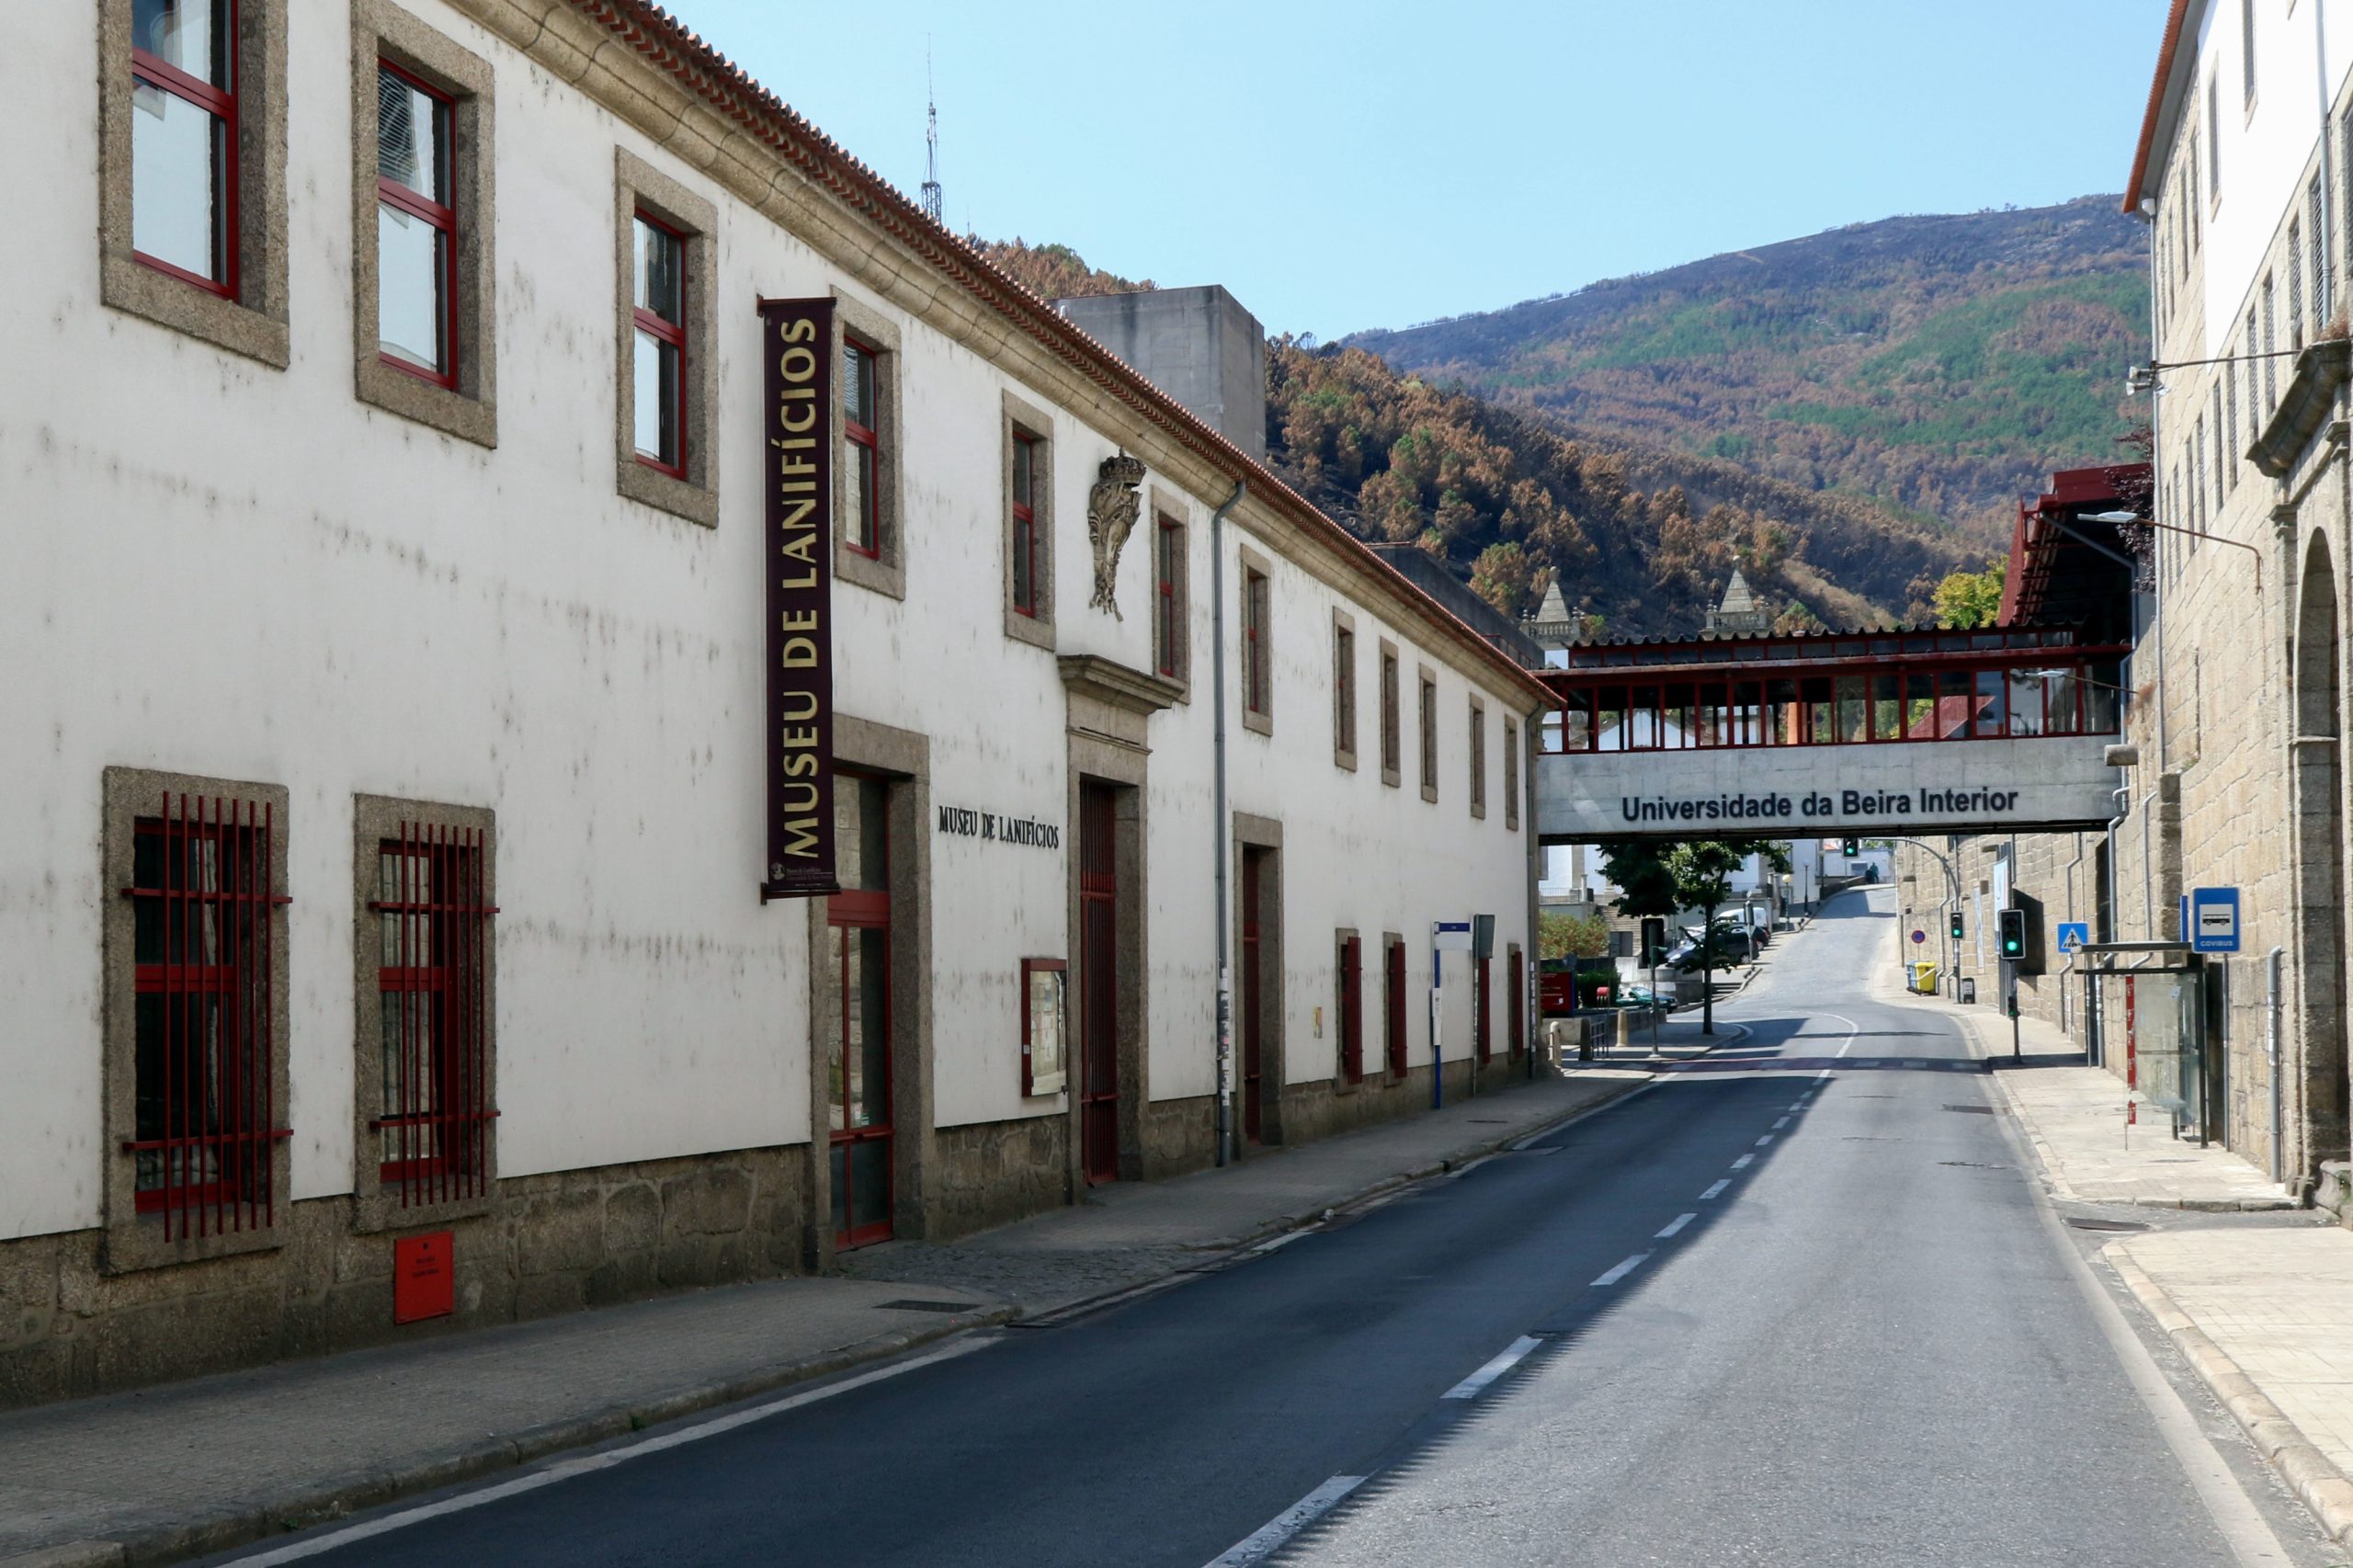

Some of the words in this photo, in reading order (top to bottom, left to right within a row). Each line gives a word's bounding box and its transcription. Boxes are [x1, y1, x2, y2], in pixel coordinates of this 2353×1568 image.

[770, 318, 817, 588] LANIFÍCIOS
[783, 609, 817, 668] DE
[783, 691, 818, 858] MUSEU
[1622, 791, 1792, 822] Universidade
[1801, 791, 1834, 817] da
[1842, 789, 1912, 816] Beira
[1920, 786, 2019, 813] Interior
[938, 805, 979, 836] MUSEU
[982, 812, 995, 840] DE
[999, 815, 1060, 850] LANIFÍCIOS
